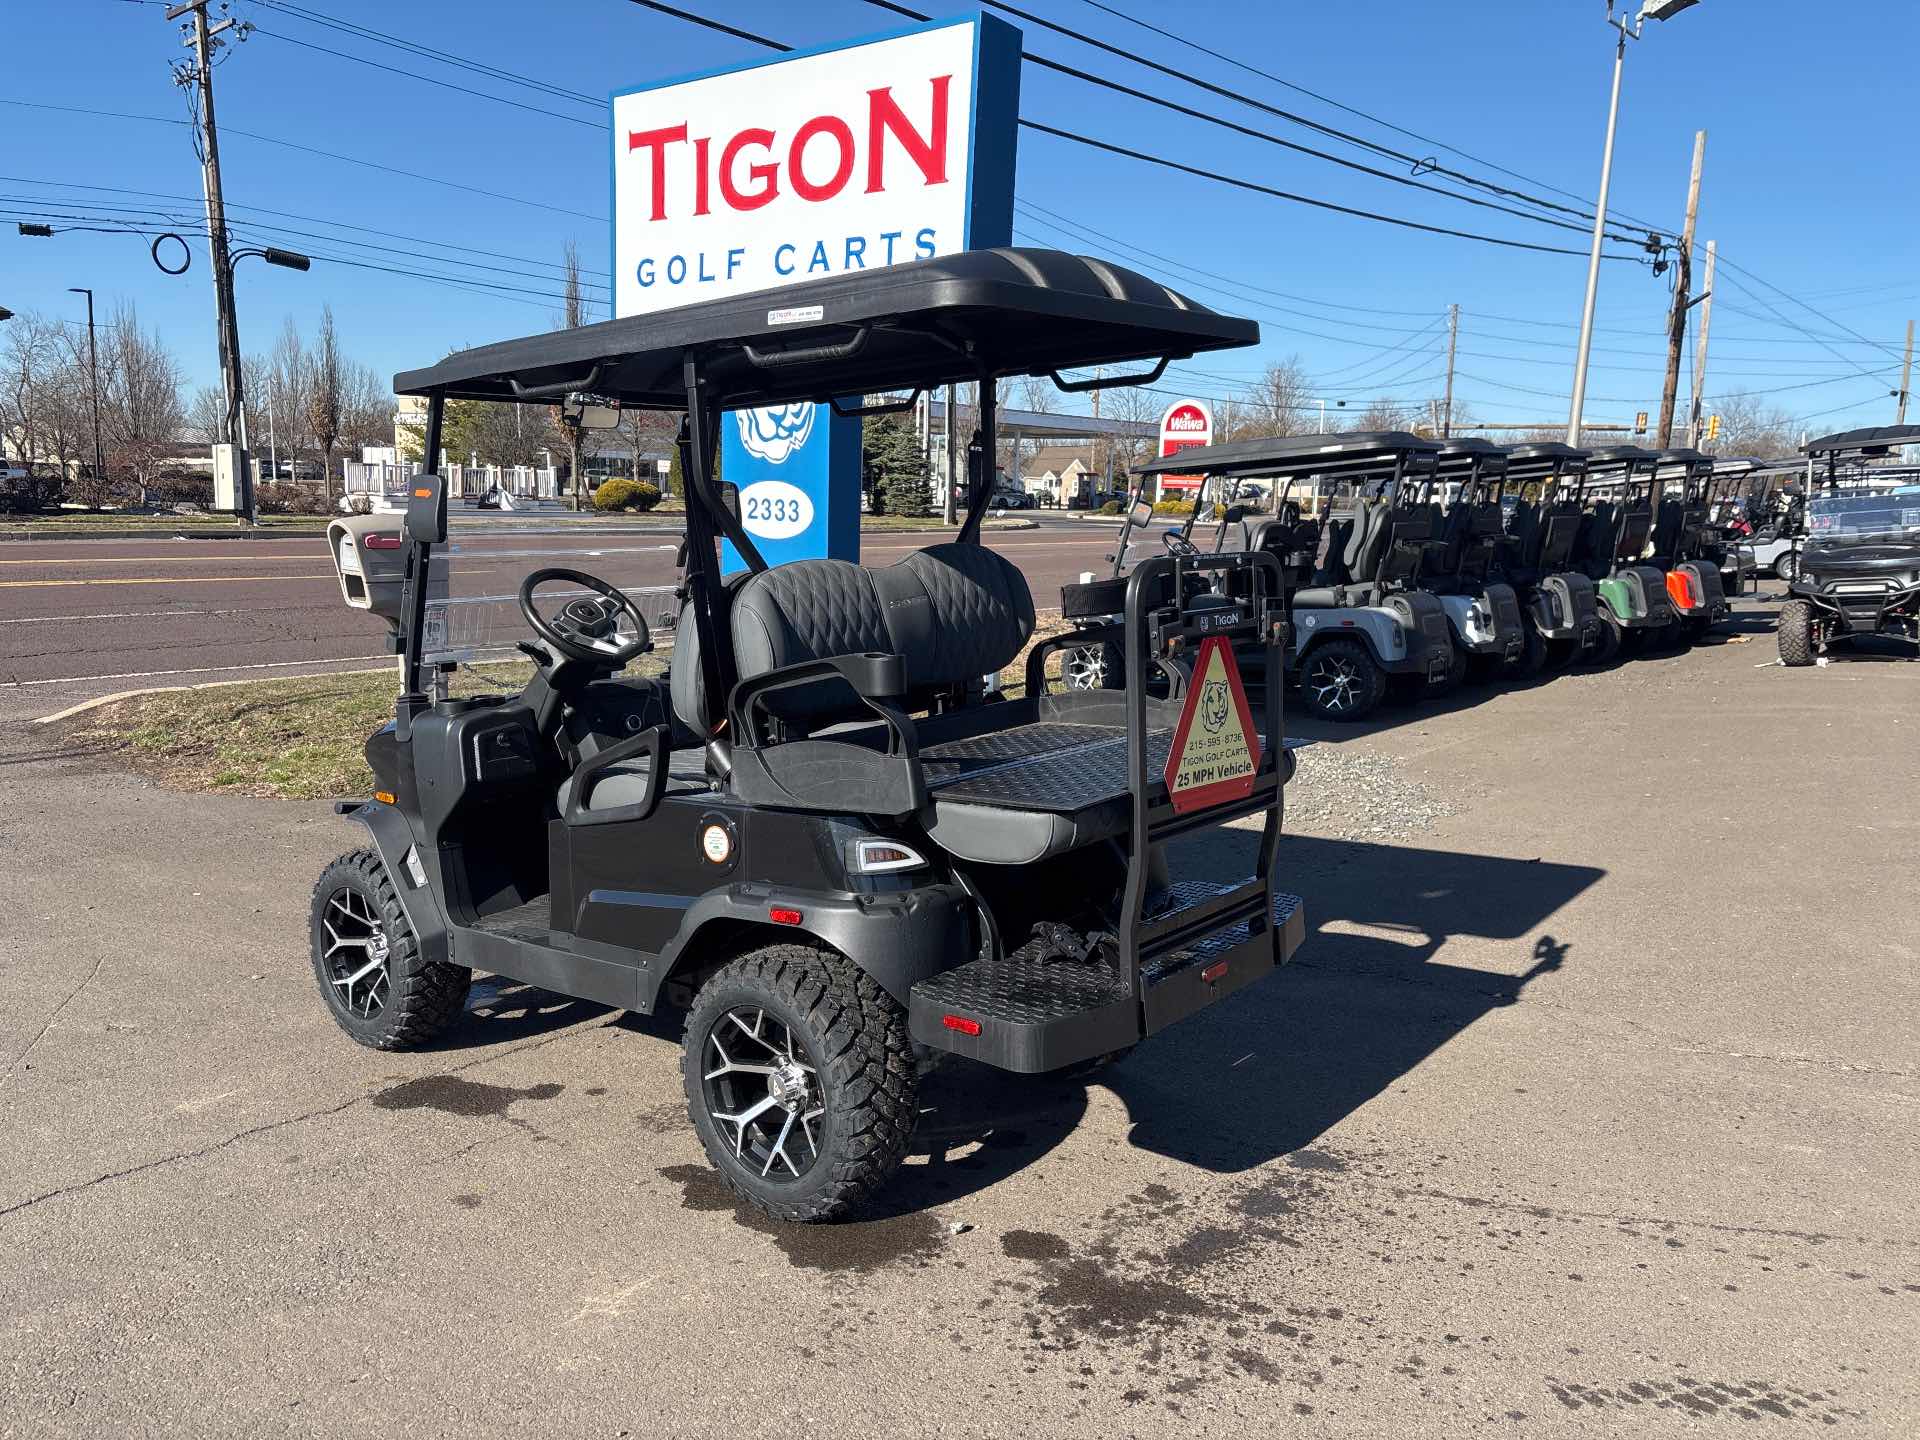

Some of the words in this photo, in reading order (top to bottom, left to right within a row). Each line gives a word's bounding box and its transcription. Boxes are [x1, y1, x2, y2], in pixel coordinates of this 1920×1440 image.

[628, 74, 953, 222] TIGON
[636, 247, 746, 288] GOLF
[773, 227, 937, 276] CARTS
[1170, 416, 1204, 431] Wawa
[746, 497, 800, 523] 2333
[1213, 612, 1239, 626] TIGON
[1183, 756, 1203, 767] TIGON
[1206, 751, 1224, 761] GOLF
[1178, 773, 1189, 787] 25
[1192, 767, 1214, 784] MPH
[1217, 760, 1252, 777] Vehicle
